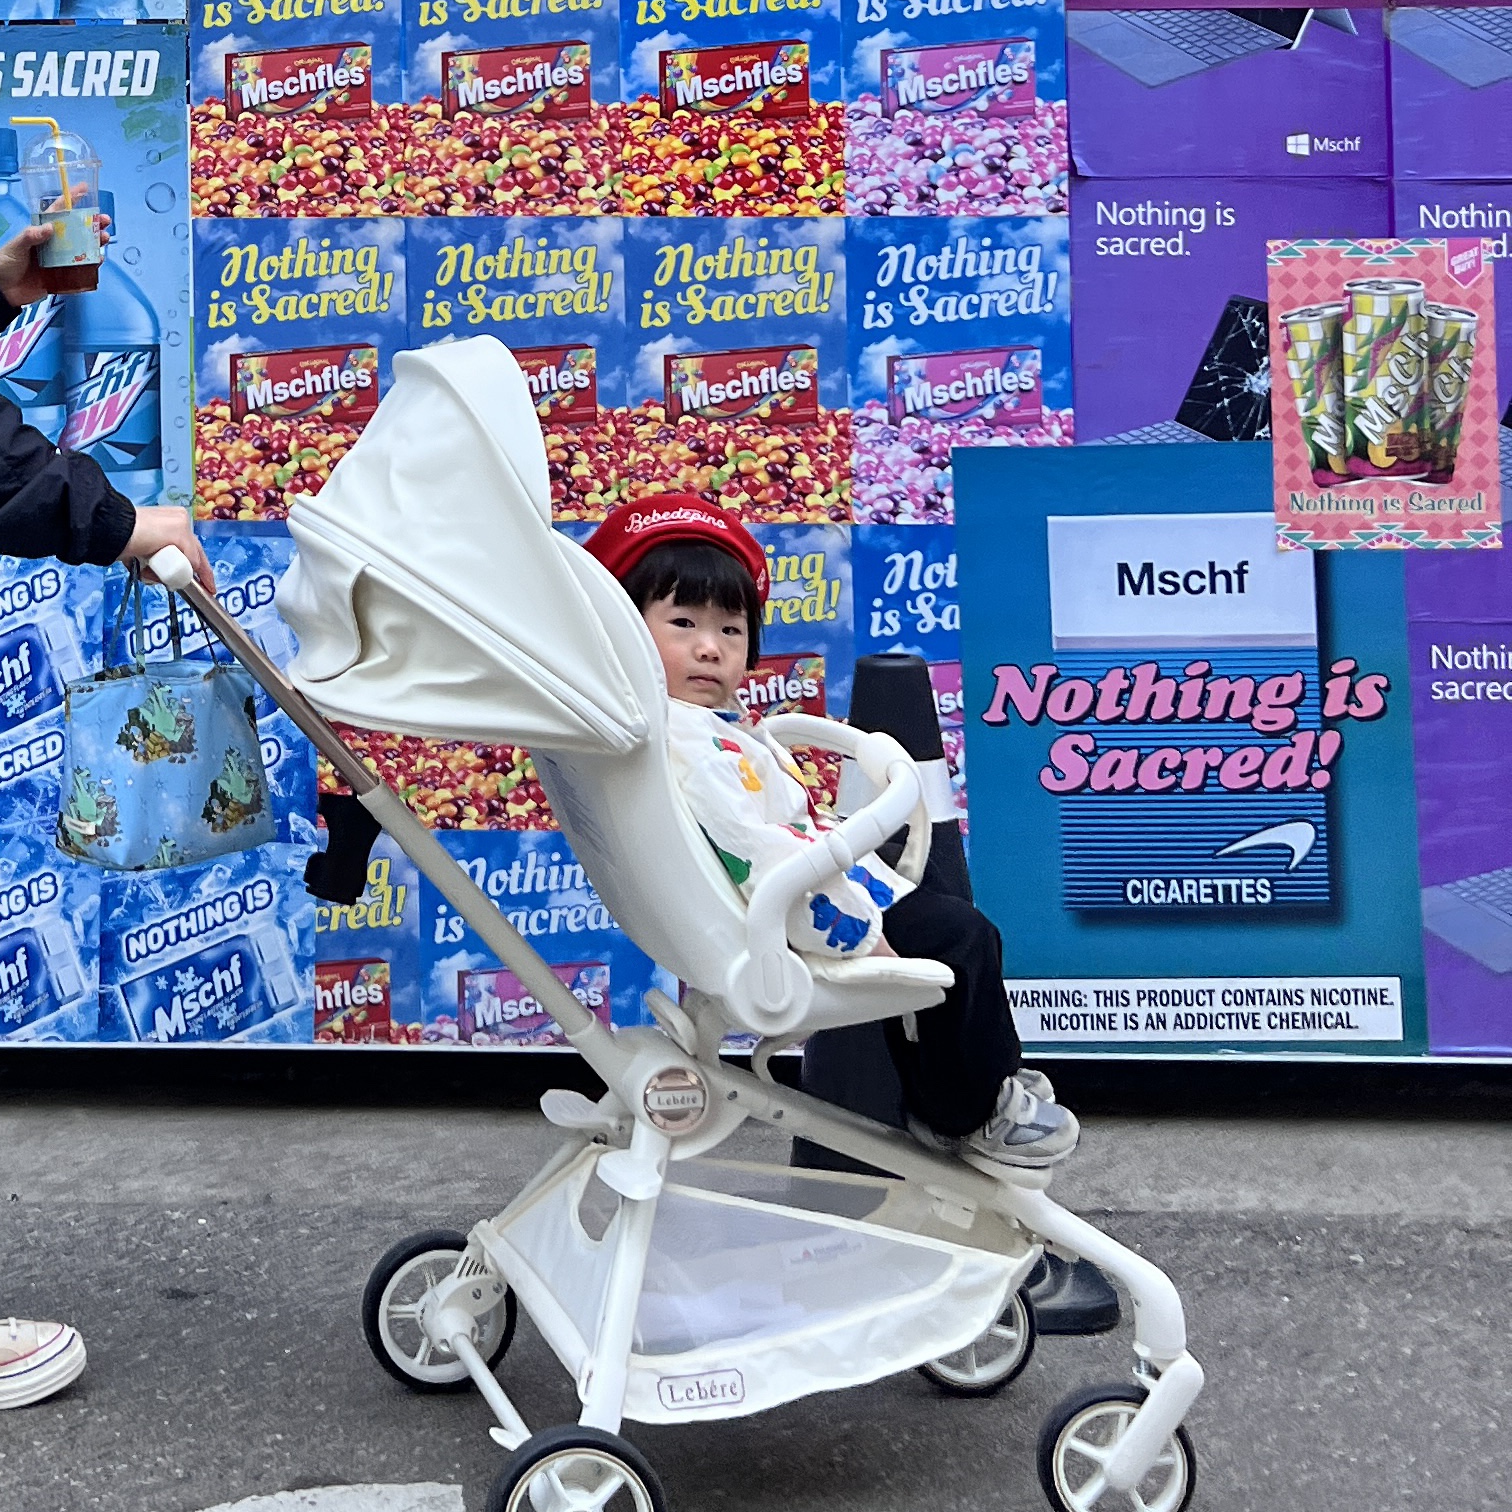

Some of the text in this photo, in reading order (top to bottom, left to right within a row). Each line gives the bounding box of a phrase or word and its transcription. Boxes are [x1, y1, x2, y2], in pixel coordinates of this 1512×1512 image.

[11, 49, 161, 97] SACRED
[241, 59, 366, 110] Mschfles
[457, 60, 584, 110] Mschfles
[675, 60, 803, 107] Mschfles
[896, 59, 1028, 108] Mschfles
[1313, 136, 1361, 153] Mschf
[1095, 200, 1236, 234] Nothing is
[220, 237, 379, 287] Nothing
[436, 235, 598, 287] Nothing
[653, 235, 819, 287] Nothing
[876, 236, 1042, 288] Nothing
[1095, 231, 1191, 257] sacred.
[207, 271, 393, 328] is Sacred!
[422, 270, 613, 328] is Sacred!
[639, 270, 834, 329] is Sacred!
[861, 271, 1058, 330] is Sacred!
[246, 362, 372, 411] Mschfles
[680, 364, 812, 412] Mschfles
[904, 365, 1036, 413] Mschfles
[624, 506, 728, 534] Bebedepino
[1290, 491, 1483, 515] Nothing is Sacred
[30, 569, 60, 603] IS
[243, 576, 275, 609] IS
[1116, 561, 1249, 596] Mschf
[869, 598, 901, 638] is
[982, 657, 1391, 737] Nothing is
[1039, 729, 1344, 795] Sacred!
[28, 871, 59, 906] IS
[1126, 878, 1272, 905] CIGARETTES
[125, 879, 274, 963] NOTHING IS
[434, 904, 465, 944] is
[153, 952, 244, 1042] Mschf
[1007, 988, 1394, 1009] WARNING: THIS PRODUCT CONTAINS NICOTINE.
[1040, 1011, 1359, 1031] NICOTINE IS AN ADDICTIVE CHEMICAL.
